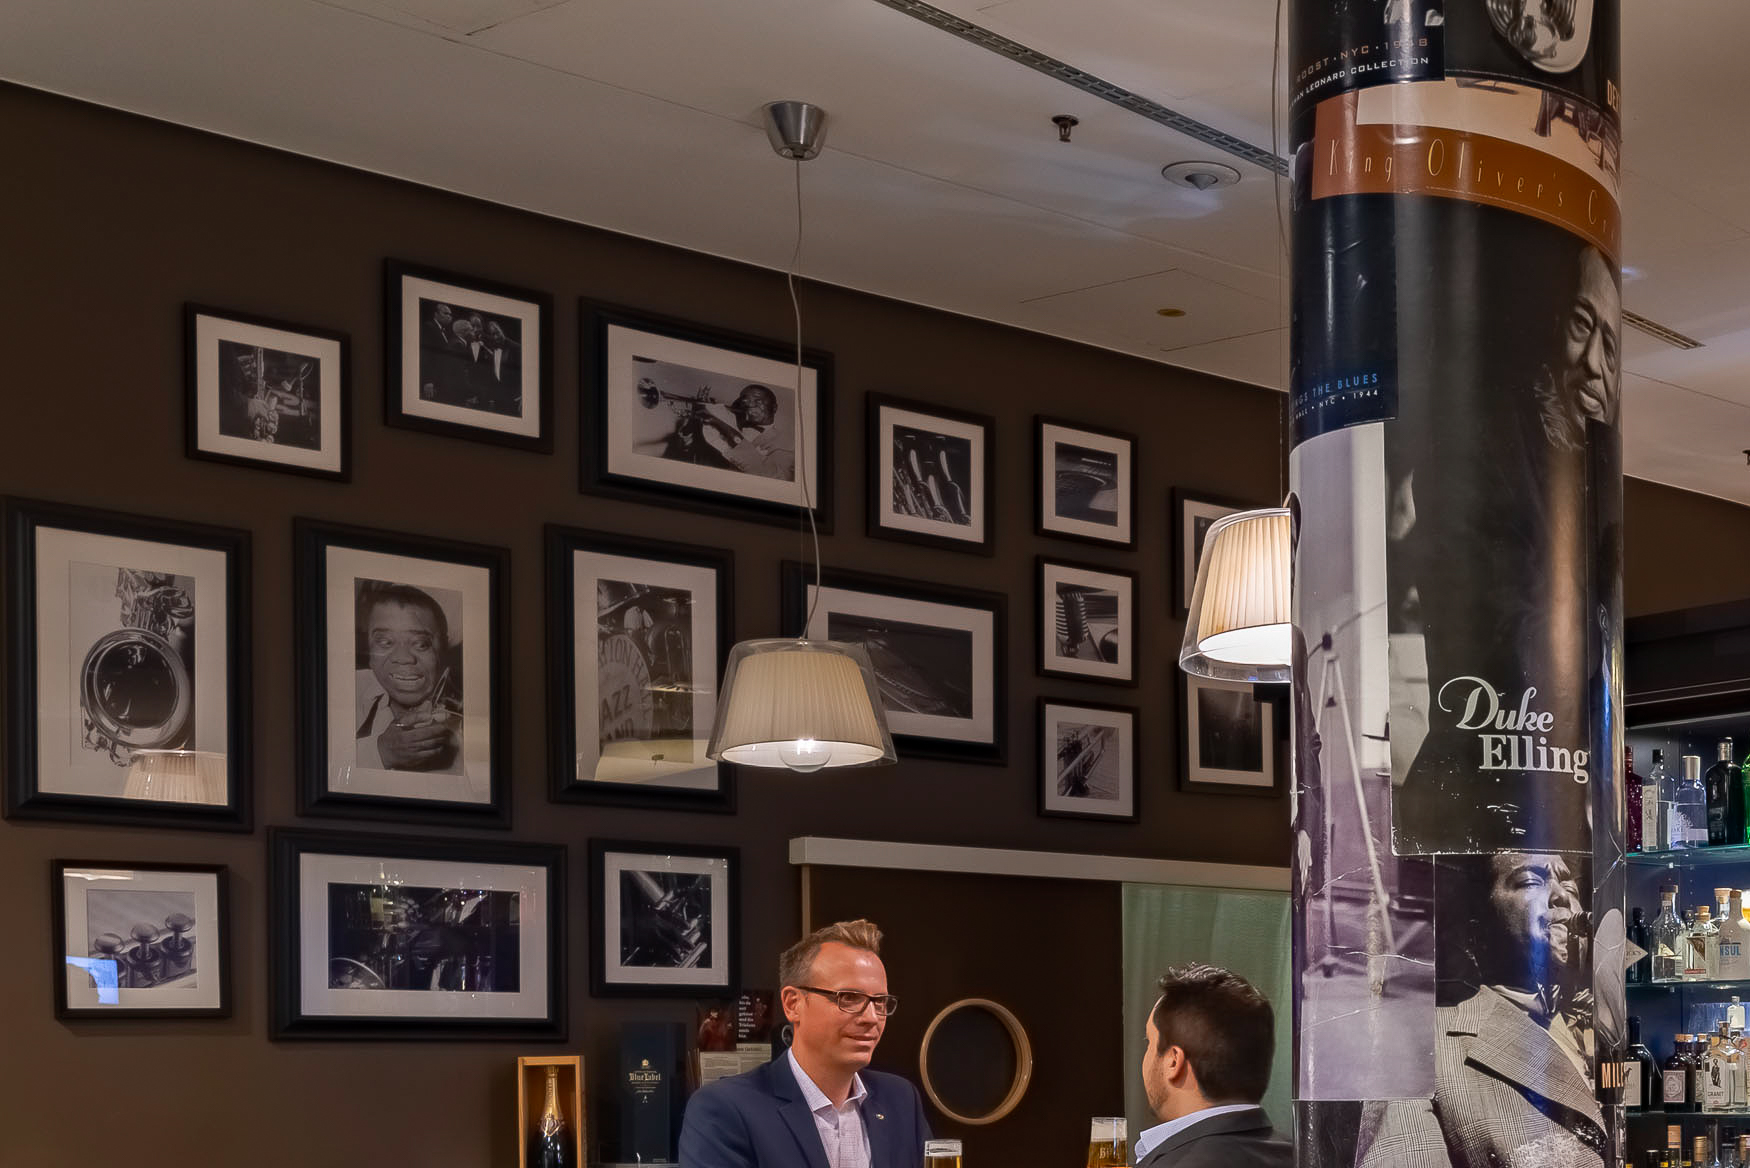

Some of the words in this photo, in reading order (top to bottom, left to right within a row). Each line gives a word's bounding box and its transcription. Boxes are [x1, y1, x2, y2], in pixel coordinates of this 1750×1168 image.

[1340, 45, 1369, 60] NYC
[1384, 38, 1428, 50] 198
[1305, 70, 1346, 93] LEONARD
[1350, 57, 1429, 75] COLLECTON
[1329, 139, 1394, 183] King
[1427, 138, 1565, 208] Oliver's
[1313, 383, 1331, 397] THE
[1337, 373, 1378, 390] BLUES
[1353, 389, 1379, 400] 1944
[1438, 676, 1555, 732] Duke
[1478, 734, 1590, 784] Elling
[629, 1072, 644, 1081] Blue
[645, 1072, 661, 1081] Label
